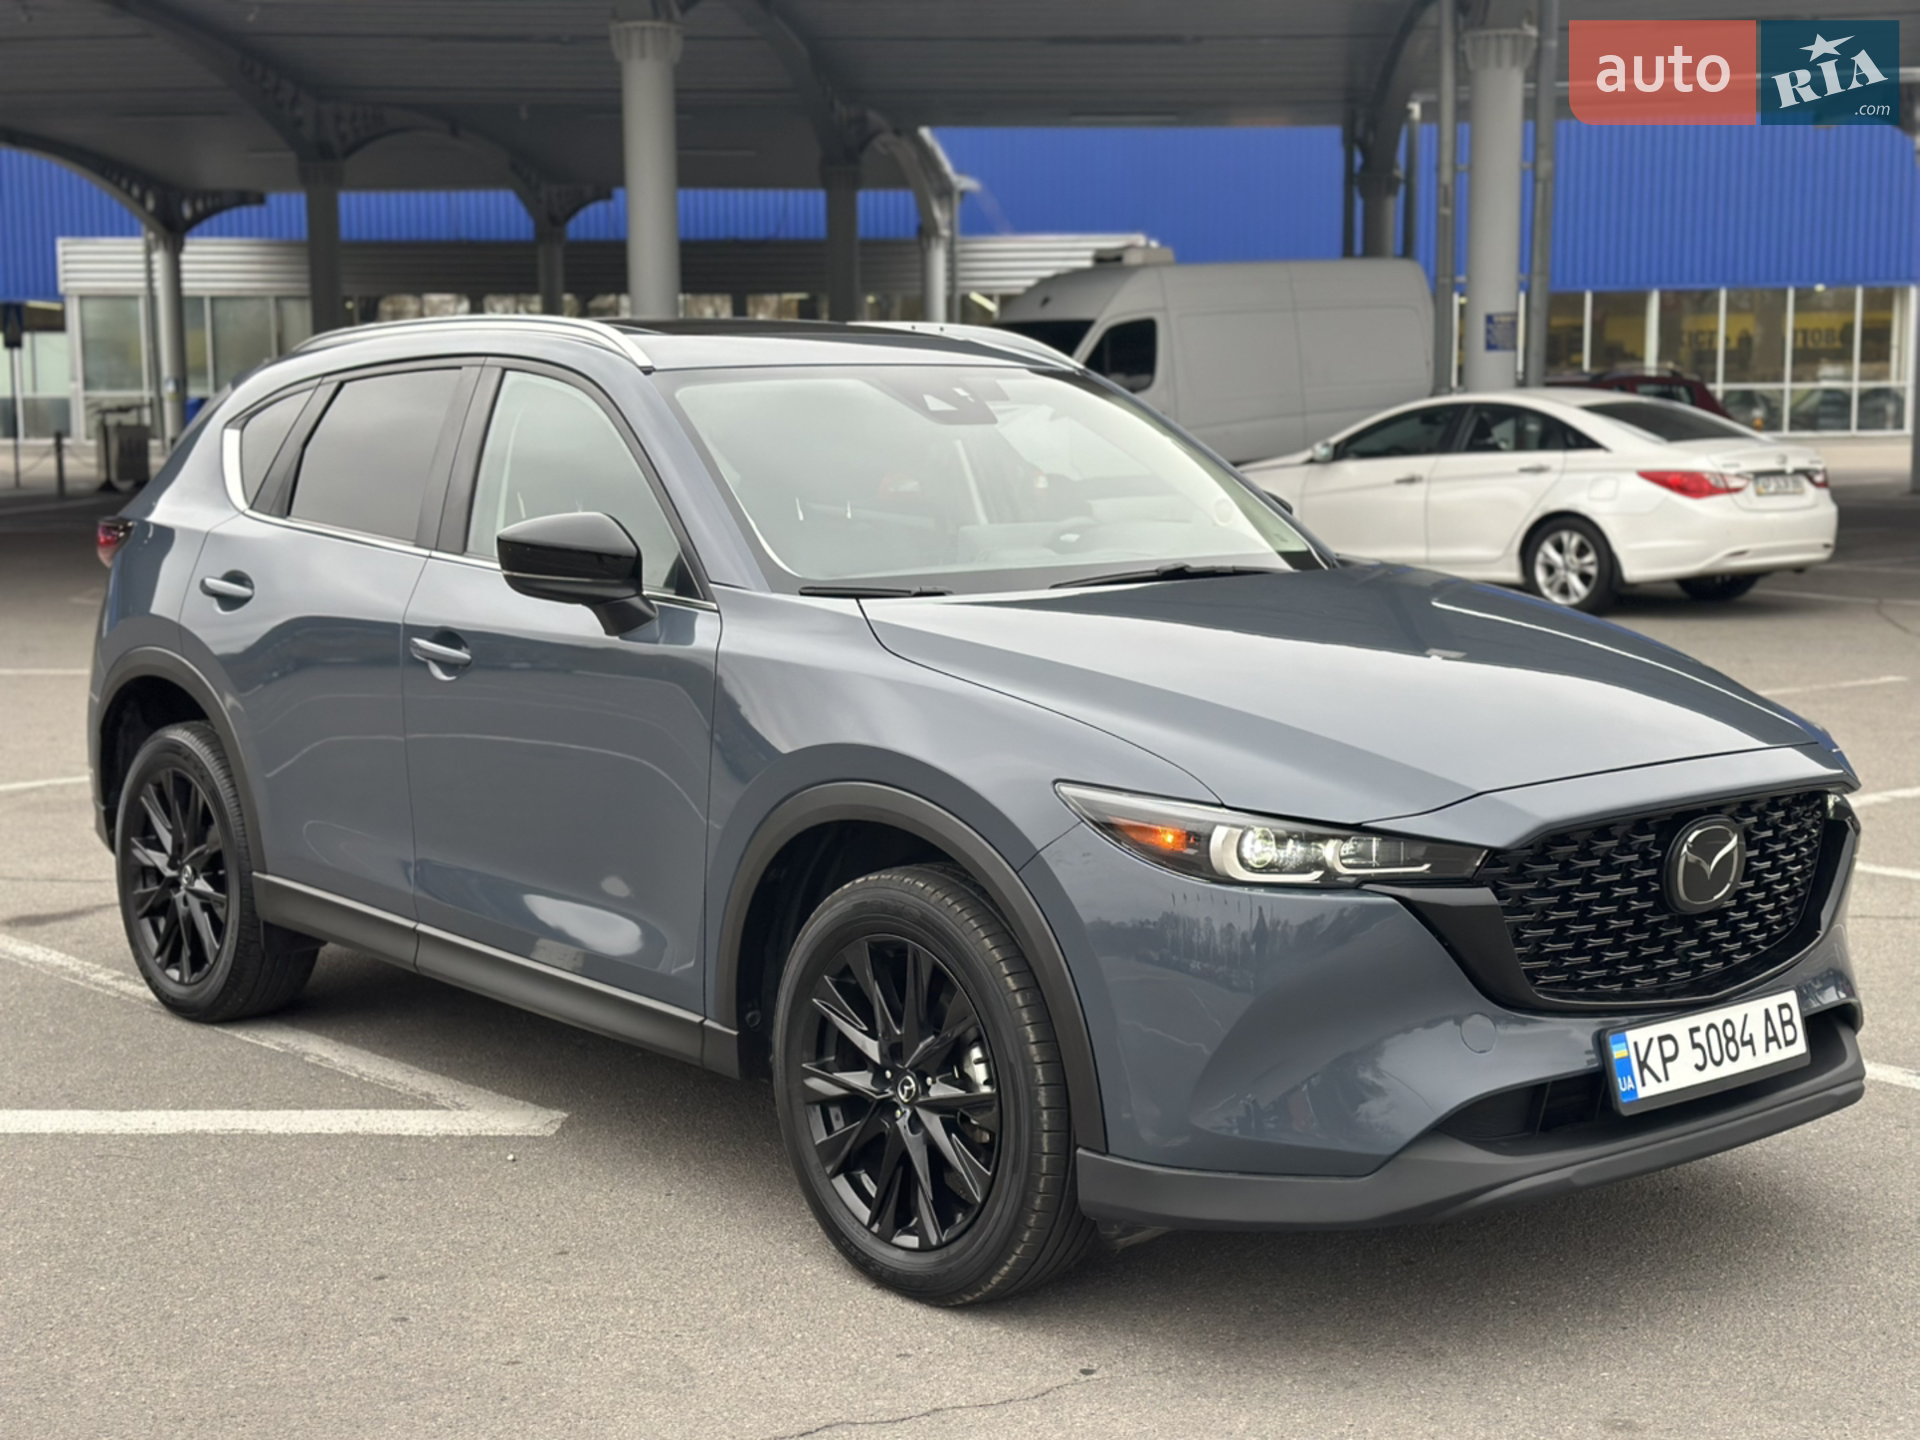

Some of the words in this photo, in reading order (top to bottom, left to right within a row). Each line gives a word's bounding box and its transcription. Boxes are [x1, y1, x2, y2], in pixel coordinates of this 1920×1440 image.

[1633, 1033, 1679, 1088] KP
[1688, 1013, 1757, 1072] 5084
[1764, 1002, 1798, 1053] AB
[1617, 1075, 1635, 1092] UA
